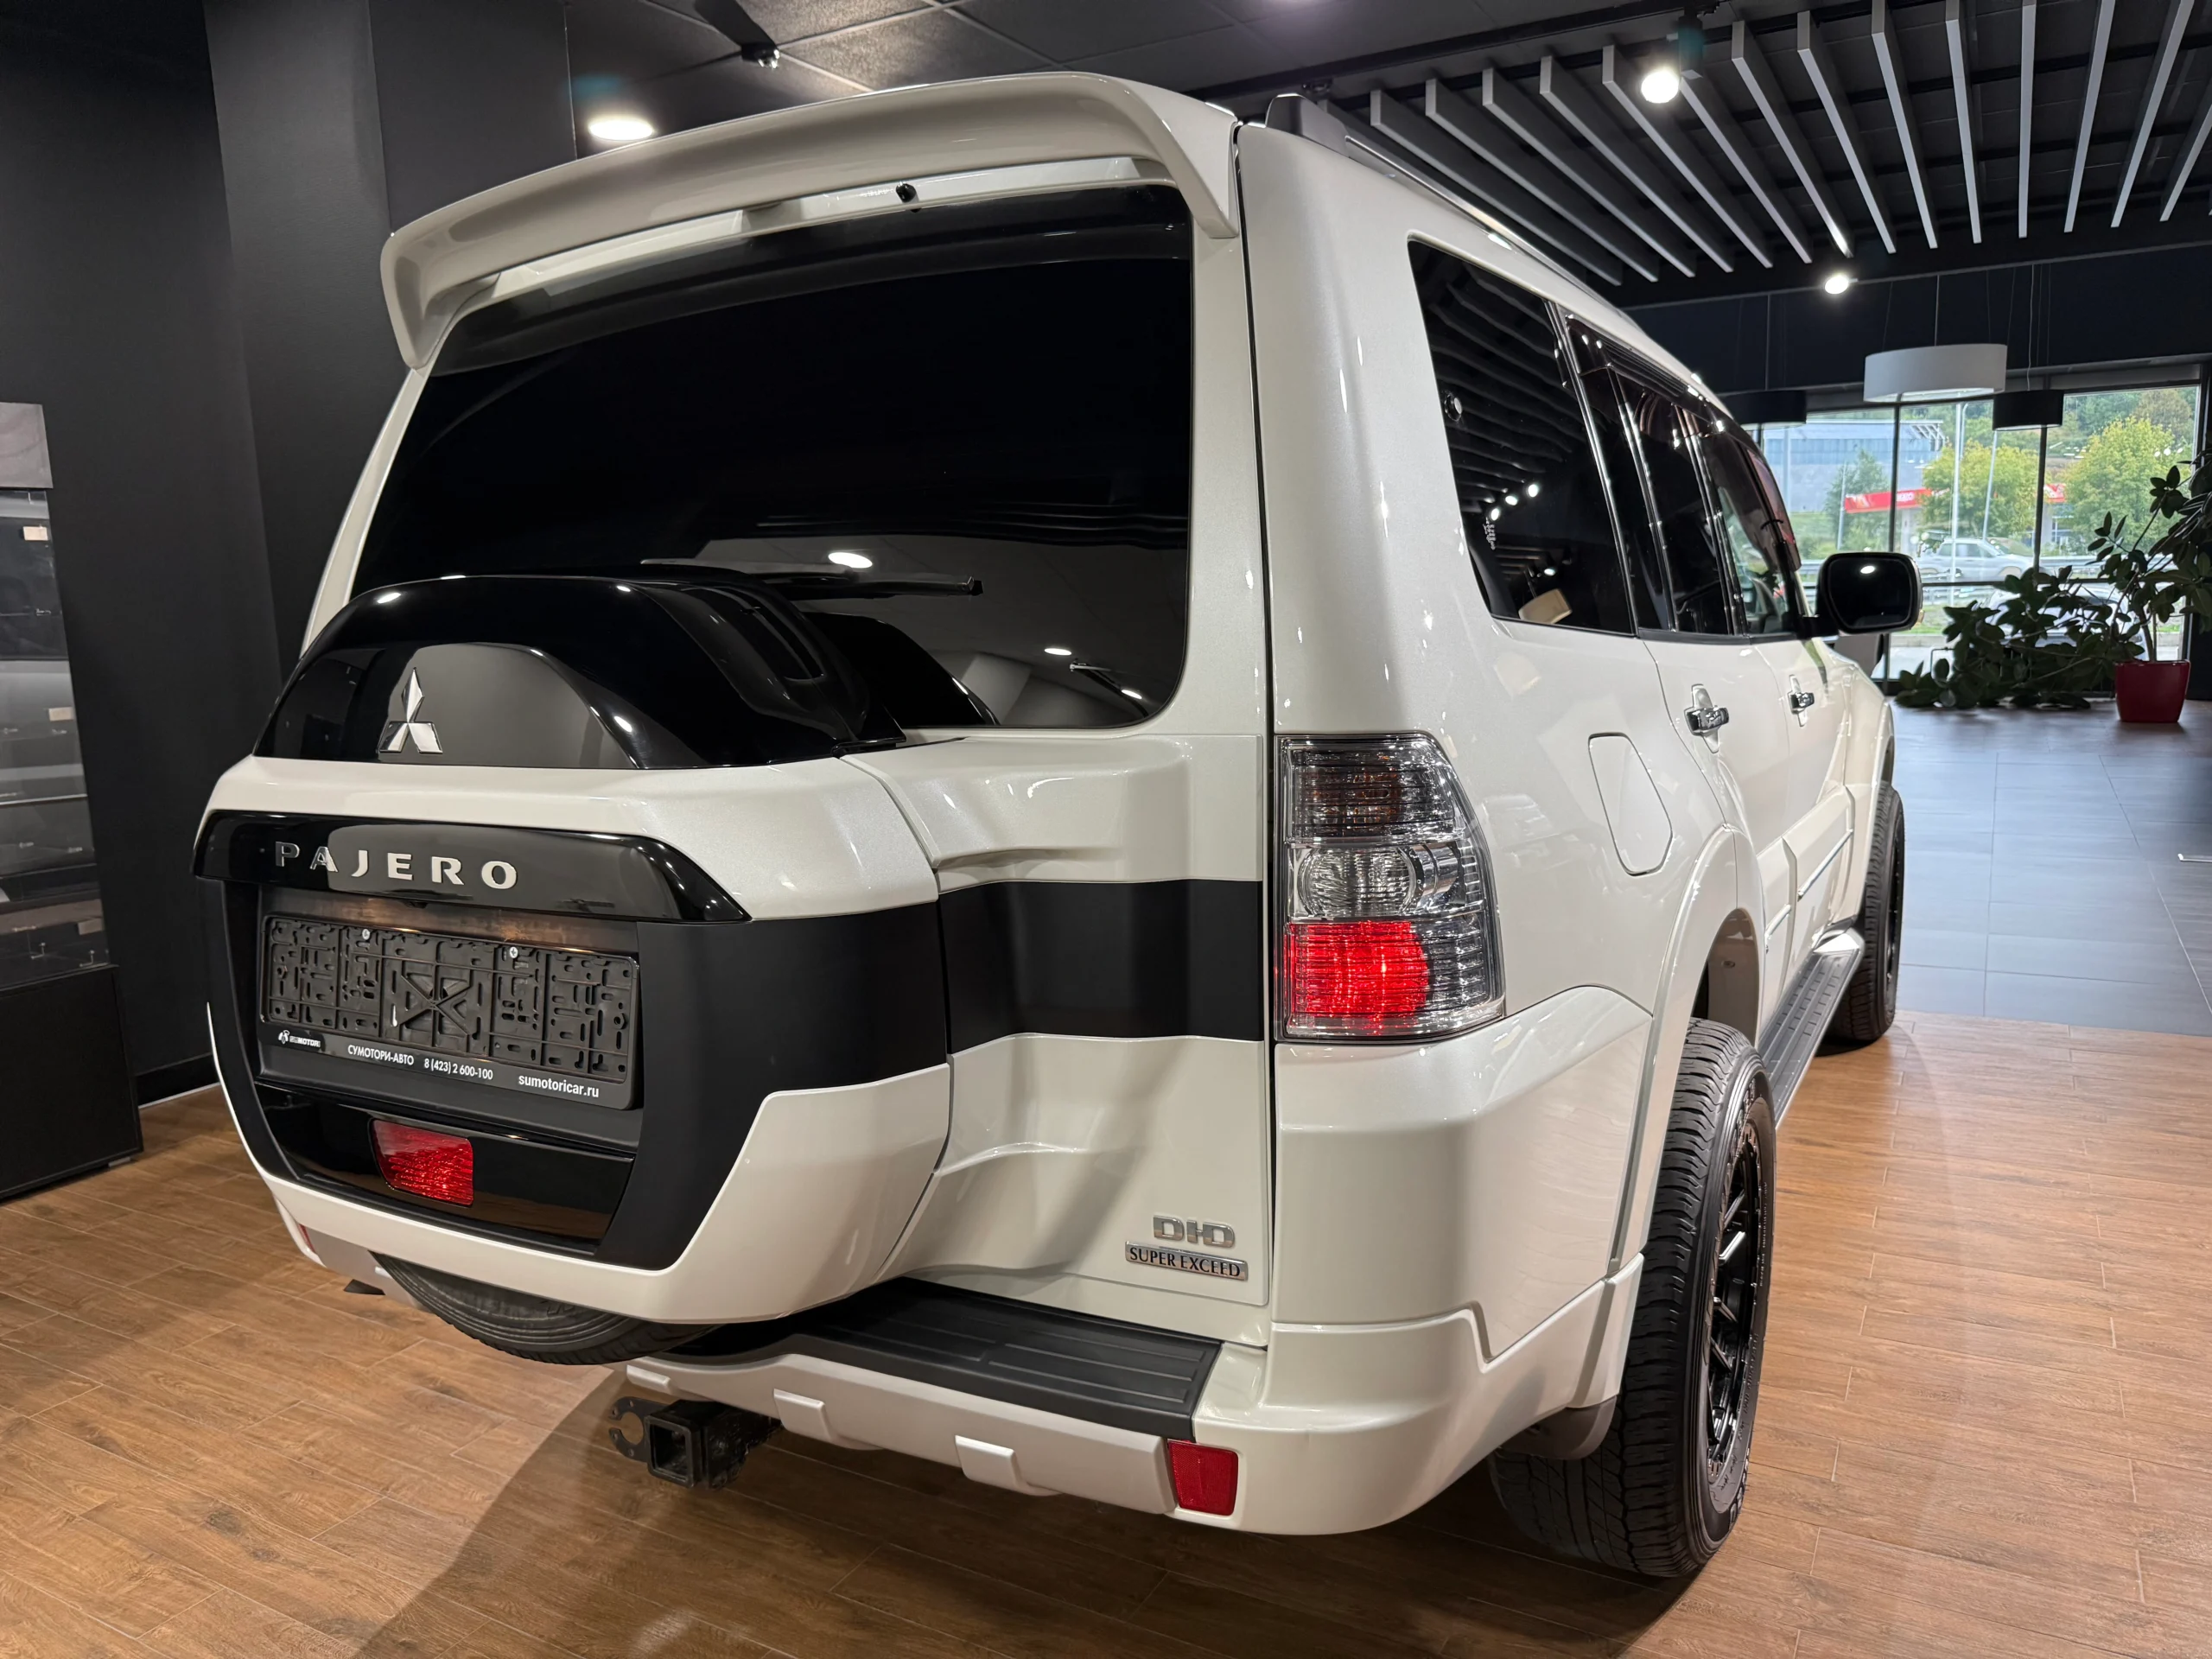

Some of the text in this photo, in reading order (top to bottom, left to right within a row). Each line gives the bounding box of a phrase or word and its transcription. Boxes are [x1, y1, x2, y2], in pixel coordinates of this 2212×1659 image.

[275, 841, 518, 890] PAJERO
[347, 1044, 493, 1080] СУМОТОРИ-АВТО 8 (423) 2 600-100
[518, 1075, 600, 1098] sumotoricar.ru
[1129, 1246, 1241, 1278] SUPER EXCEED
